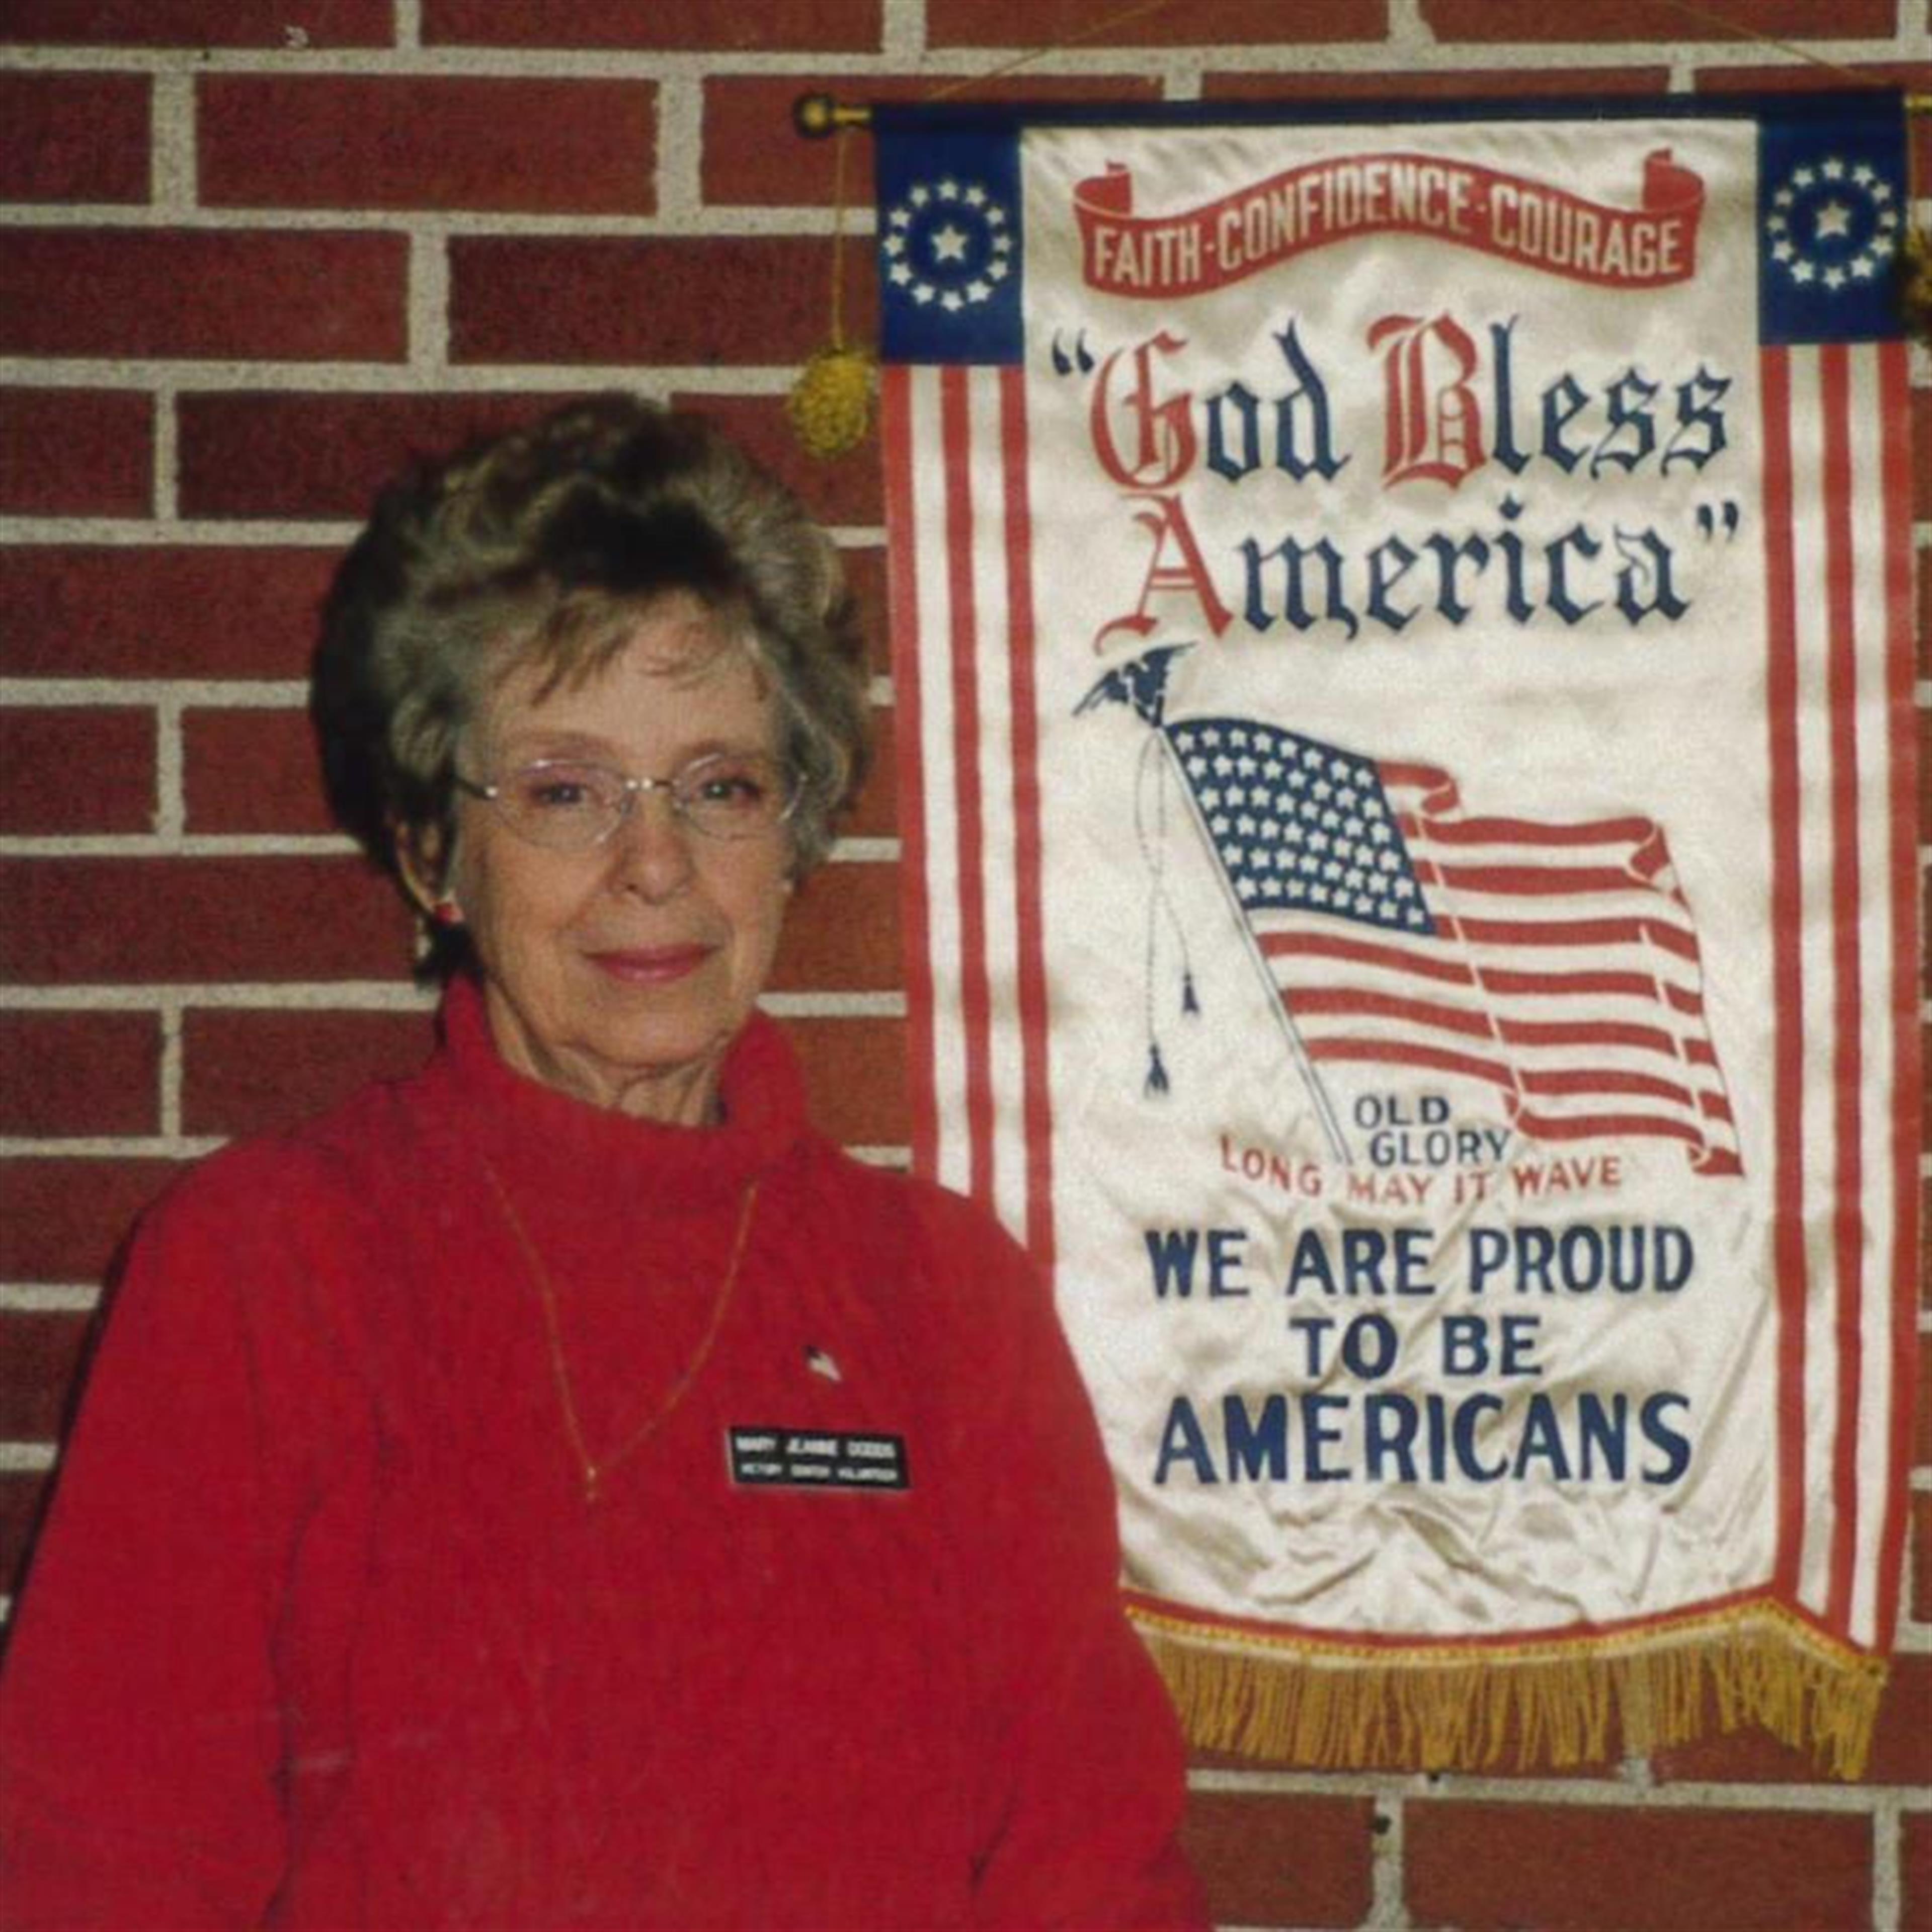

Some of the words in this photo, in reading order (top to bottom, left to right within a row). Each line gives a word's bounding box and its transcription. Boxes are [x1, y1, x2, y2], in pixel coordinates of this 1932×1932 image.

[1365, 308, 1733, 492] Bless
[1353, 1094, 1451, 1130] OLD
[1219, 1133, 1323, 1198] LONG
[1346, 1171, 1434, 1205] MAY
[1453, 1171, 1494, 1203] IT
[1511, 1155, 1623, 1198] WAVE
[1369, 1129, 1511, 1168] GLORY
[1144, 1228, 1250, 1298] WE
[1284, 1227, 1436, 1298] ARE
[1468, 1224, 1695, 1295] PROUD
[1289, 1313, 1399, 1381] TO
[1440, 1315, 1543, 1377] BE
[1153, 1393, 1693, 1487] AMERICANS
